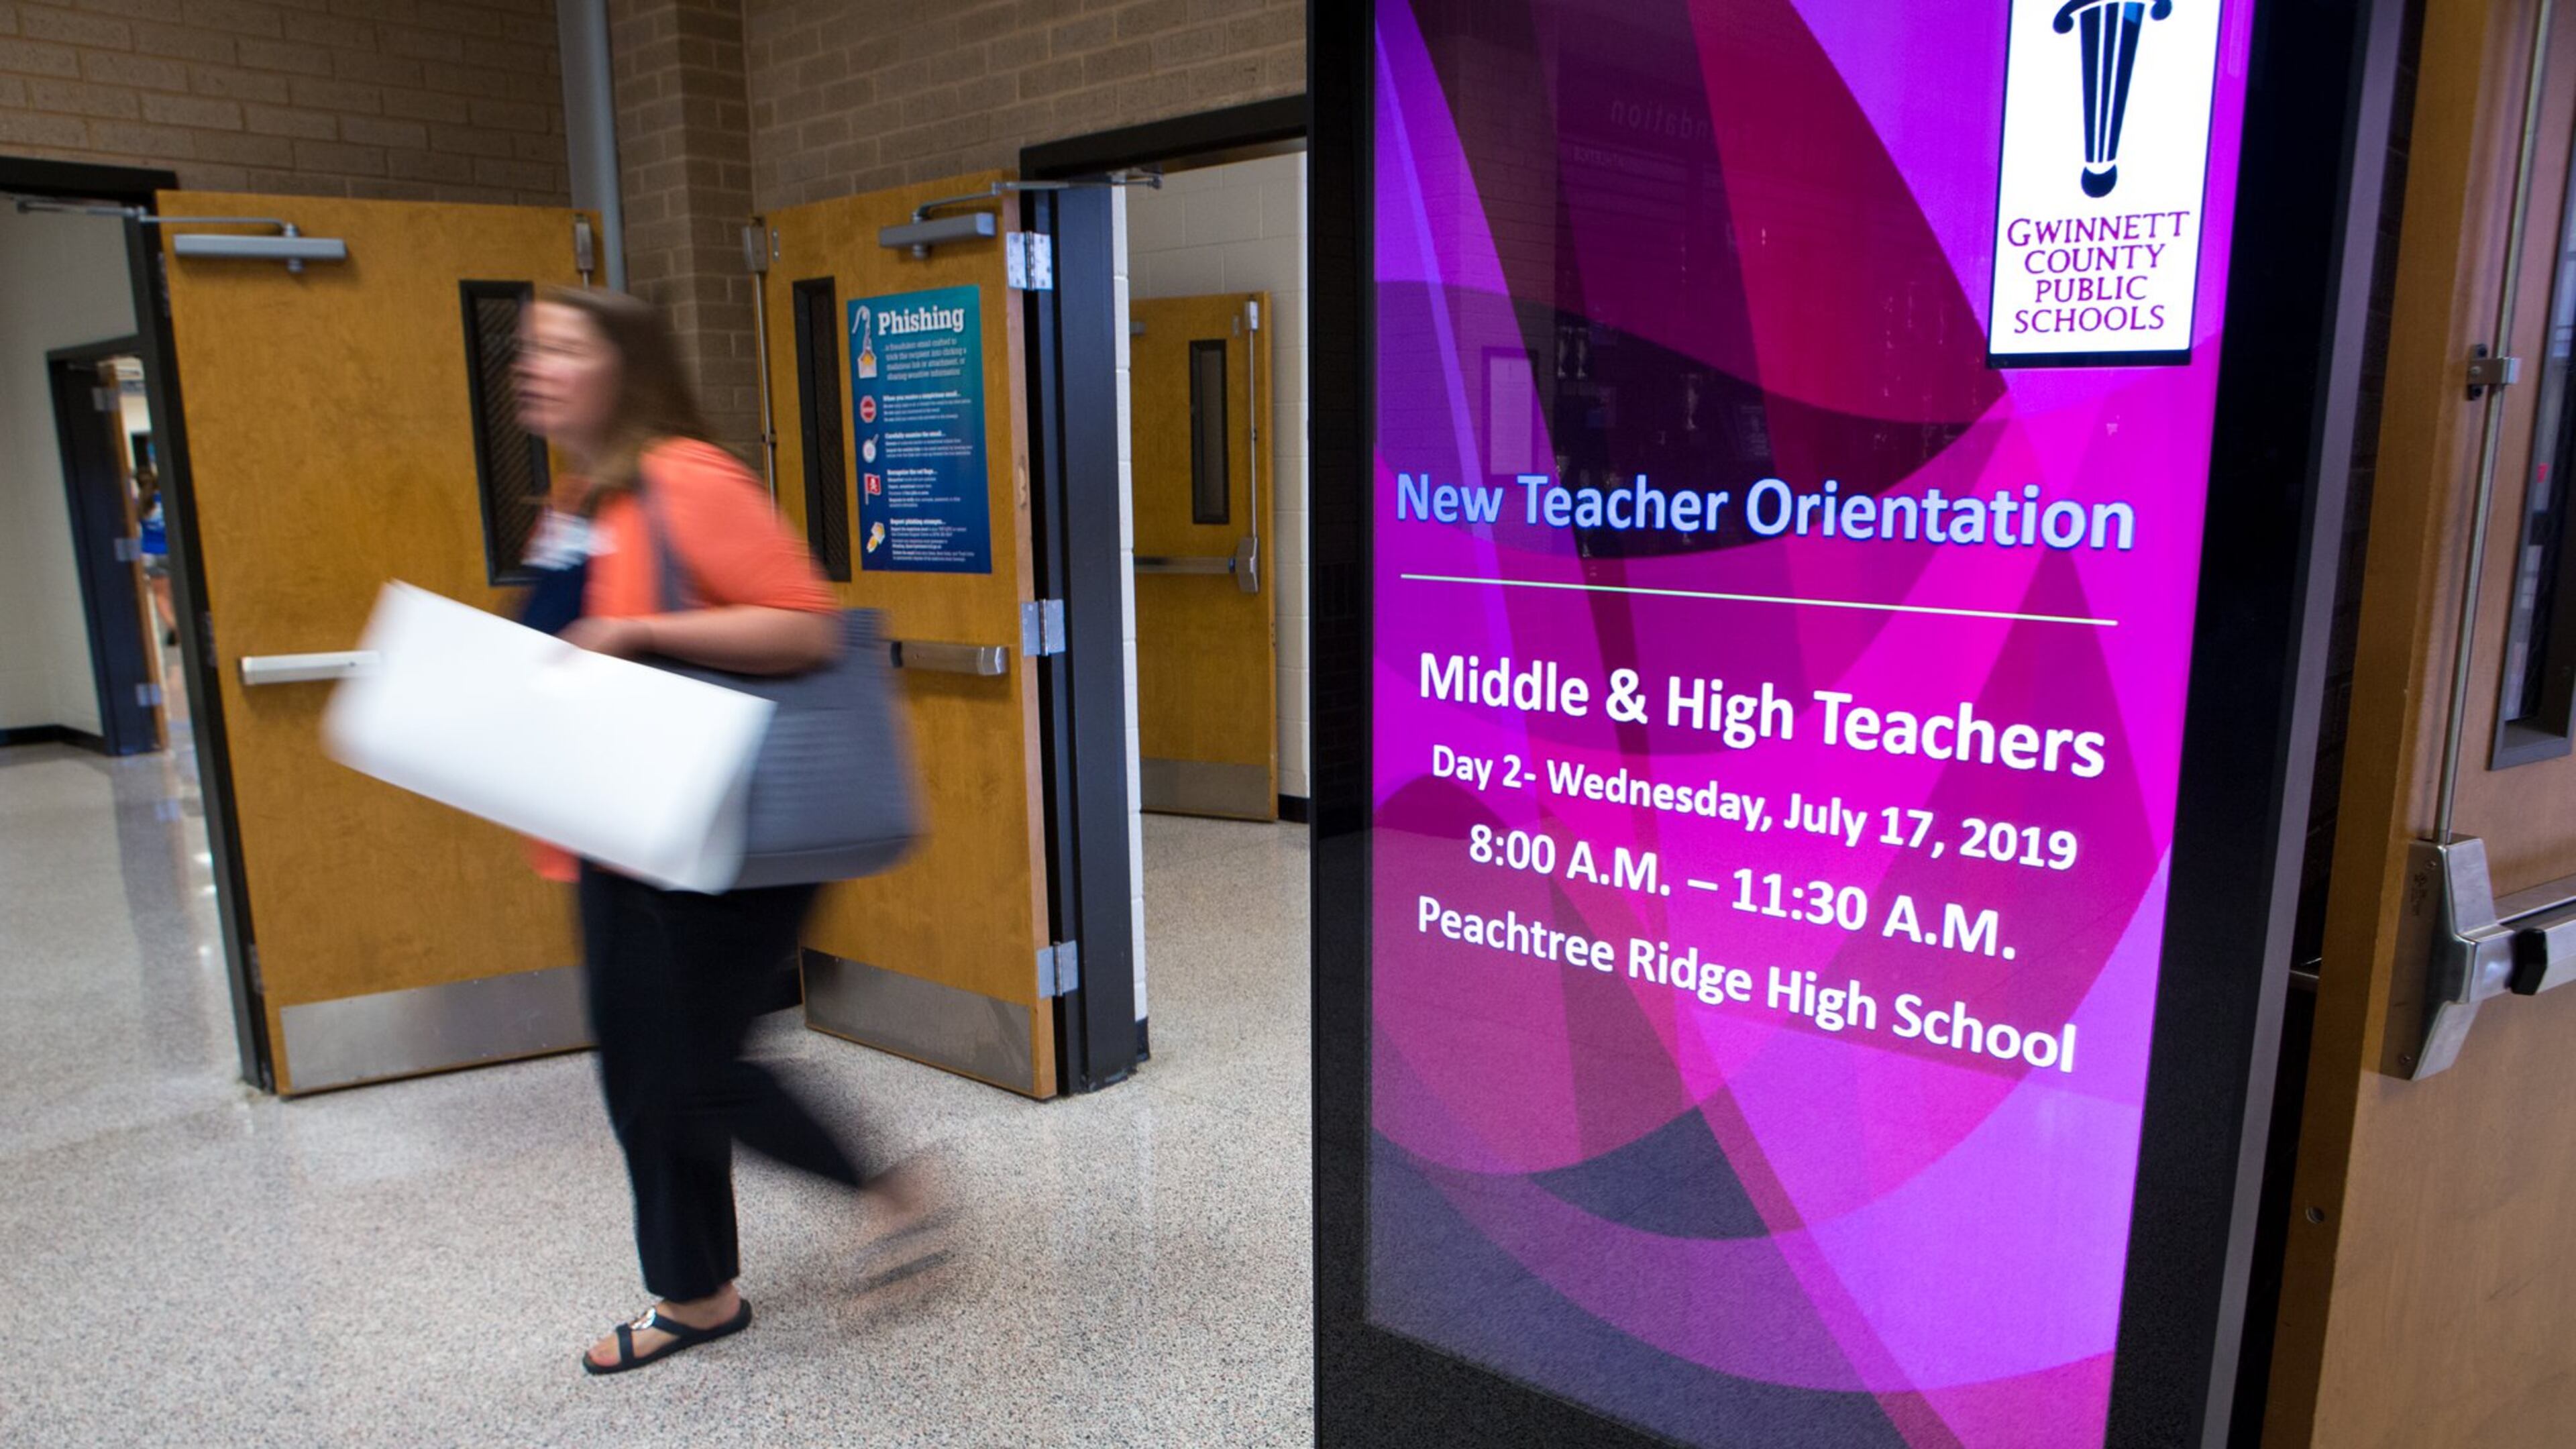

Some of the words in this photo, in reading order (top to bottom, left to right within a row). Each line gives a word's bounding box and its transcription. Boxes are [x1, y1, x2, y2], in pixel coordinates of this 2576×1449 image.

[2007, 211, 2190, 246] GWINNETT
[2025, 244, 2165, 274] COUNTY
[2035, 276, 2148, 303] PUBLIC
[878, 305, 965, 335] Phishing
[2014, 305, 2165, 333] SCHOOLS
[1397, 473, 1503, 523] New
[1517, 474, 1729, 531] Teacher
[1747, 478, 2135, 549] Orientation
[1420, 652, 1589, 717] Middle
[1605, 668, 1648, 724] &
[1668, 676, 1793, 749] High
[1813, 690, 2105, 777] Teachers
[1432, 744, 1493, 791] Day
[1502, 754, 1536, 788] 2-
[1547, 759, 1772, 832] Wednesday,
[1784, 793, 1868, 847] July
[1880, 806, 1945, 859] 17,
[1960, 818, 2078, 871] 2019
[1470, 824, 1556, 874] 8:00
[1566, 841, 1670, 896] A.M.
[1732, 867, 1868, 930] 11:30
[1882, 895, 2015, 960] A.M.
[1418, 895, 1615, 973] Peachtree
[1629, 938, 1752, 1005] Ridge
[1768, 966, 1877, 1031] High
[1892, 993, 2076, 1073] School
